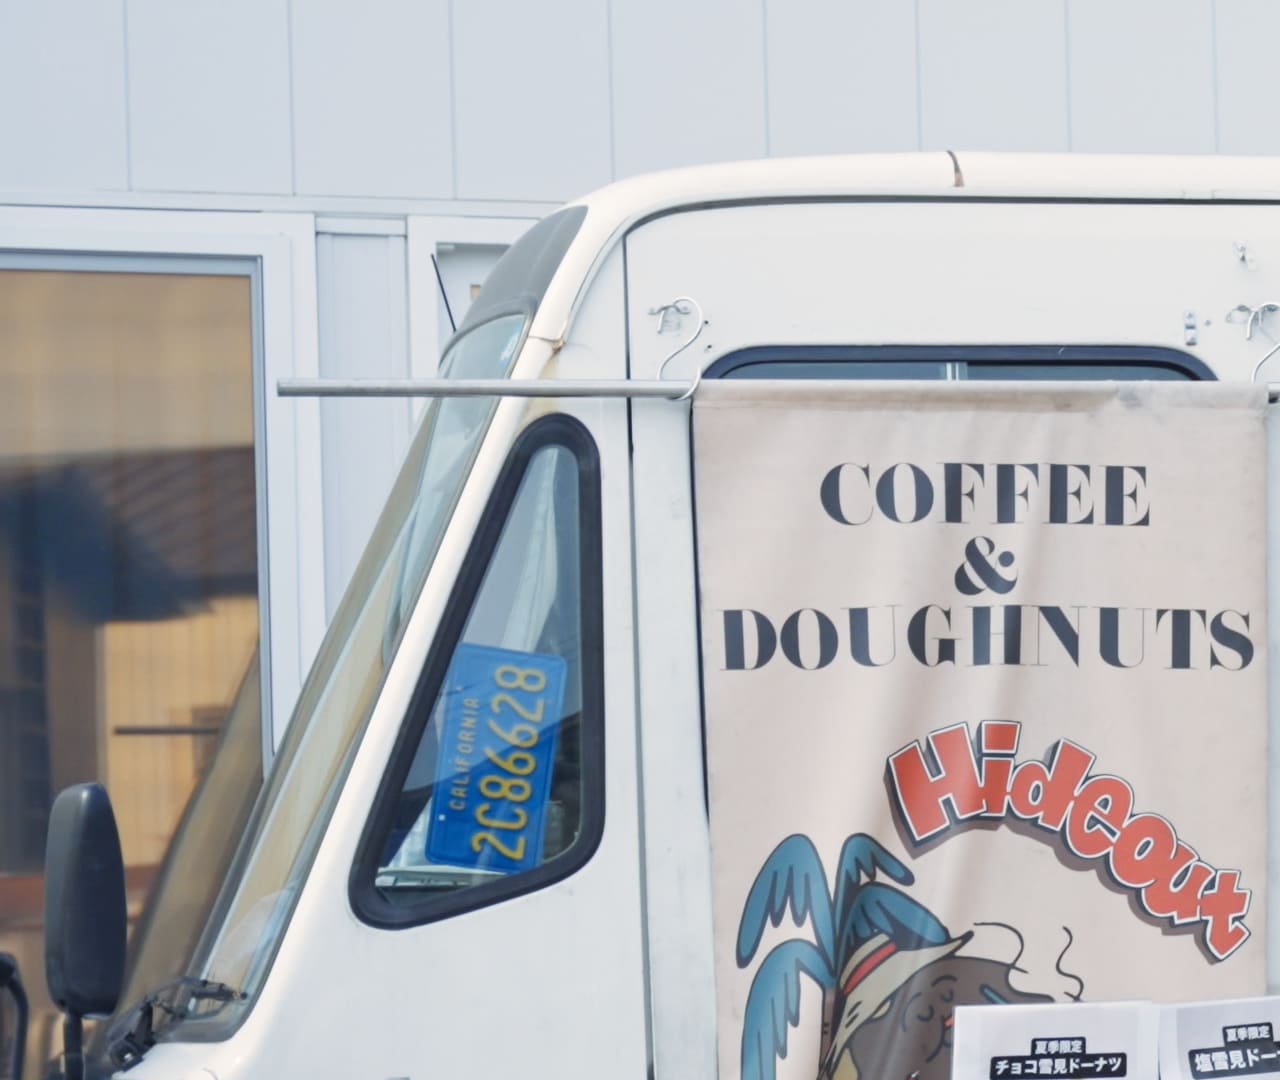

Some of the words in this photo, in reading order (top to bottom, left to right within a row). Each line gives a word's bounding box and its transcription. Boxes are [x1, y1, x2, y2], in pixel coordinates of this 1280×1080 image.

[820, 461, 1151, 526] COFFEE
[954, 535, 1018, 596] &
[718, 603, 1255, 671] DOUGHNUTS
[449, 697, 481, 811] CALIFORNIA
[470, 664, 547, 861] 2C86628
[883, 719, 1252, 966] Hideout
[994, 1056, 1122, 1075] チョコ雪見ドーナツ
[1034, 1040, 1083, 1054] 夏季限定
[1225, 1025, 1271, 1042] 夏季限定
